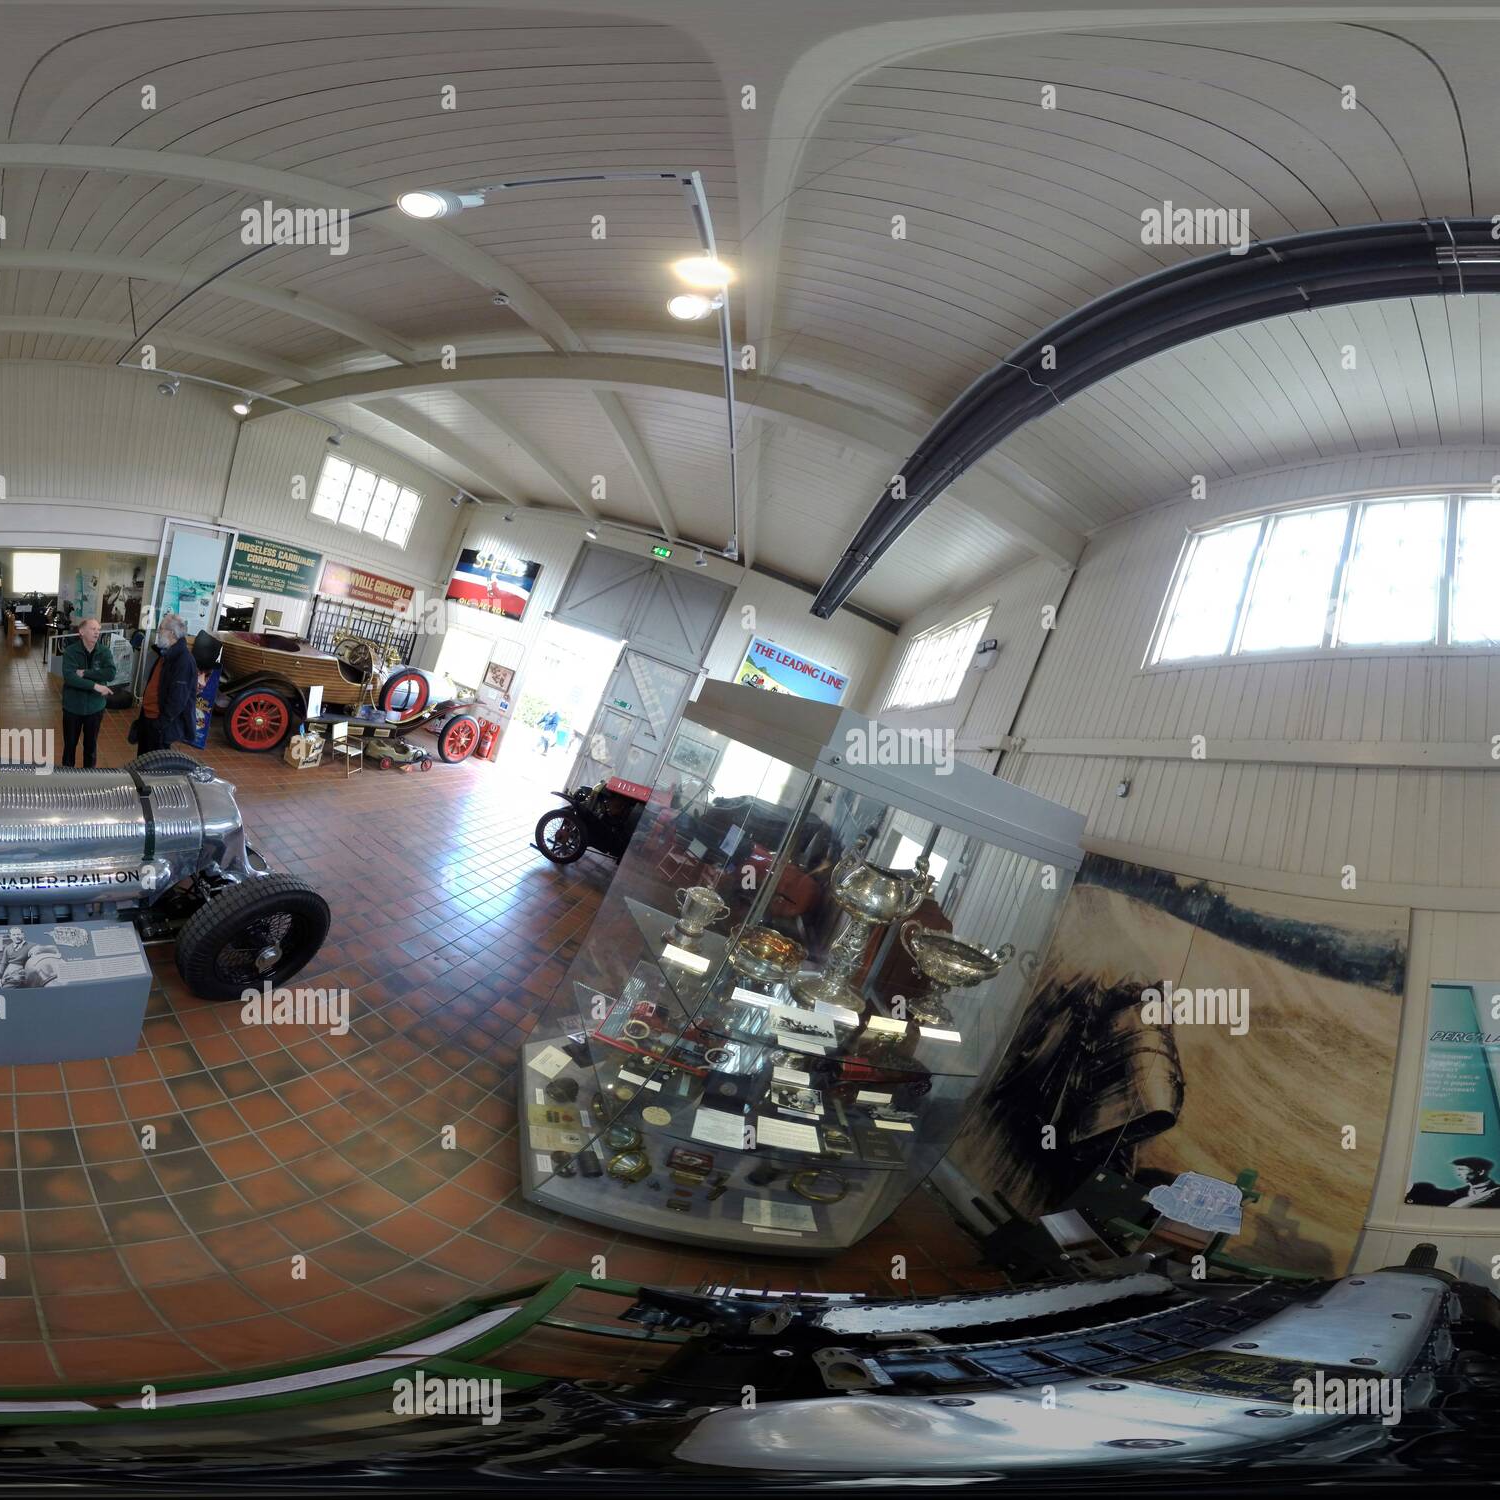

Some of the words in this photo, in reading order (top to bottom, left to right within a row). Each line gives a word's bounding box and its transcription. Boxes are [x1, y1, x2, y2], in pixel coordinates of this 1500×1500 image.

[247, 554, 299, 572] CORPORATION
[278, 550, 316, 568] CARRIAGE
[755, 642, 774, 659] THE
[776, 652, 819, 679] LEADING
[820, 669, 844, 690] LINE
[1430, 1031, 1484, 1043] PERCY
